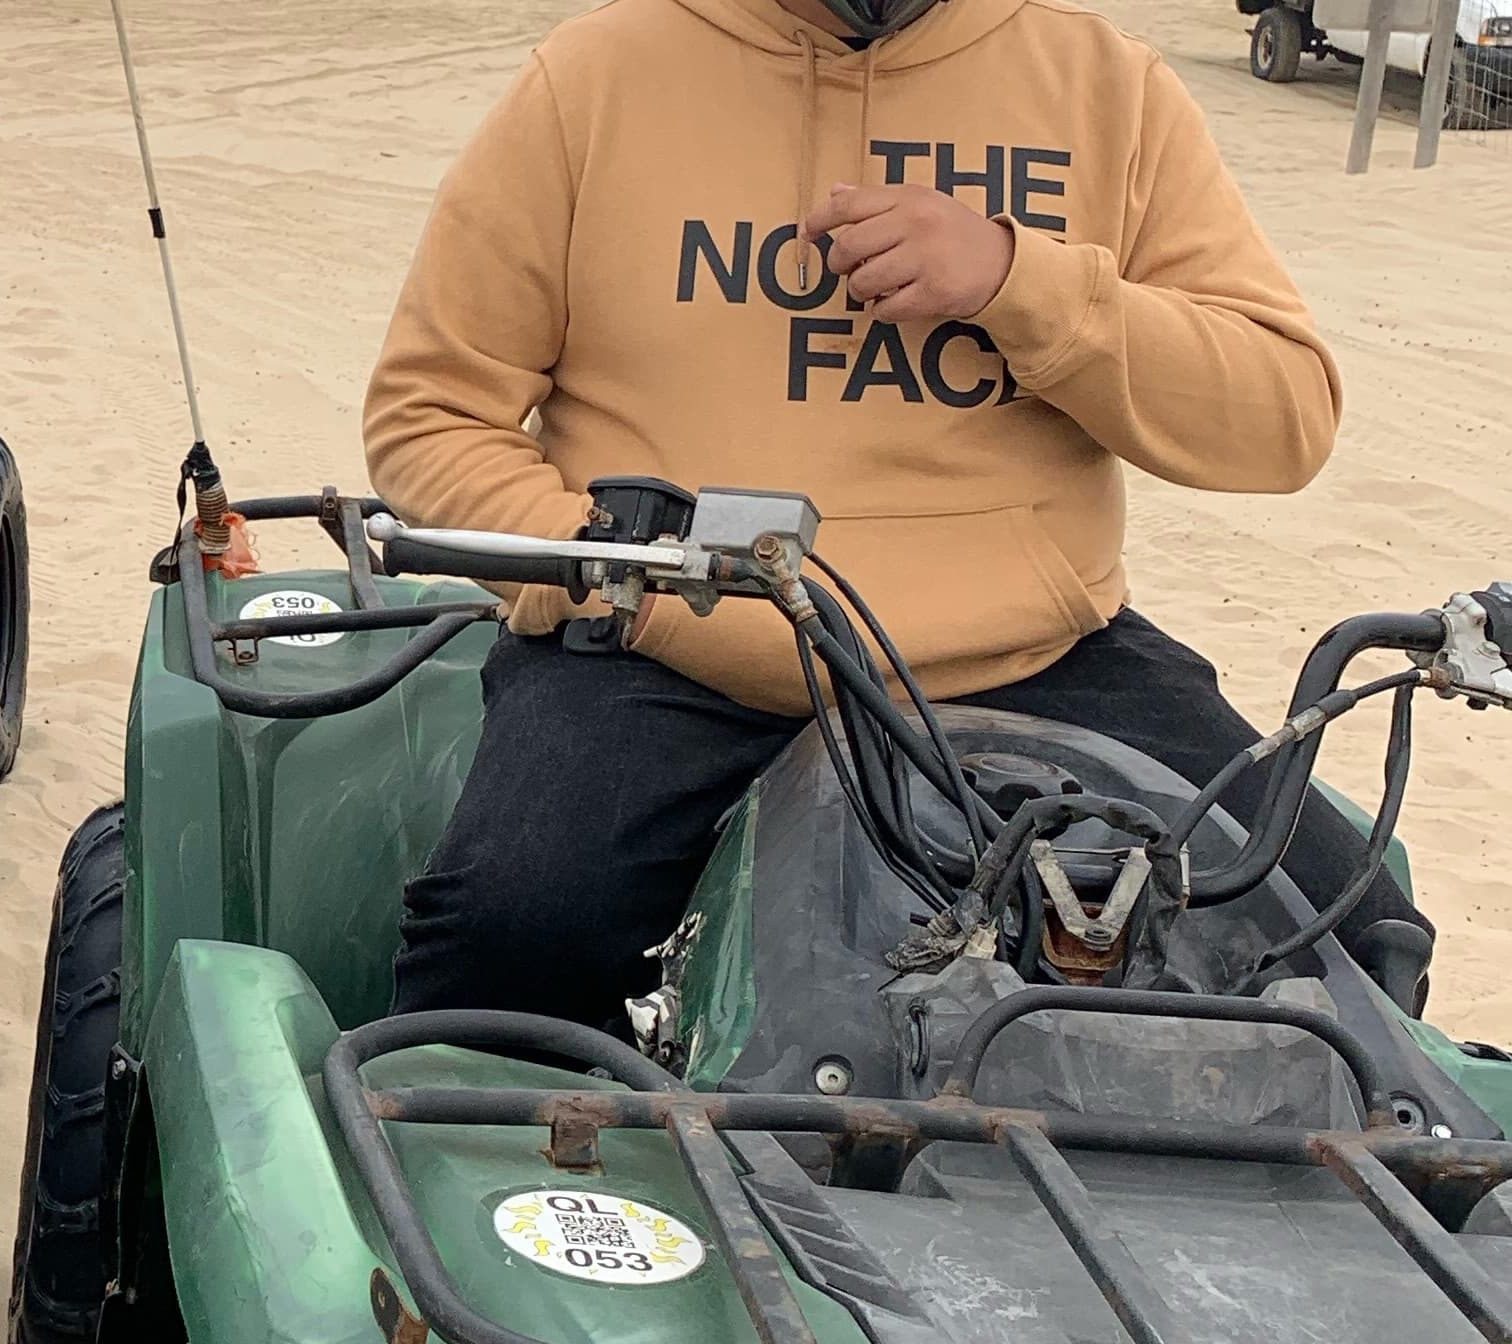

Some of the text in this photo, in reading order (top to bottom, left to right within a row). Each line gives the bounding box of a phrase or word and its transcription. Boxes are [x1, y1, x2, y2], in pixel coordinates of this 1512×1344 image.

[869, 140, 1072, 233] THE
[787, 317, 1034, 409] FAC
[271, 597, 315, 609] 053
[546, 1196, 618, 1217] QL
[564, 1248, 654, 1272] 053
